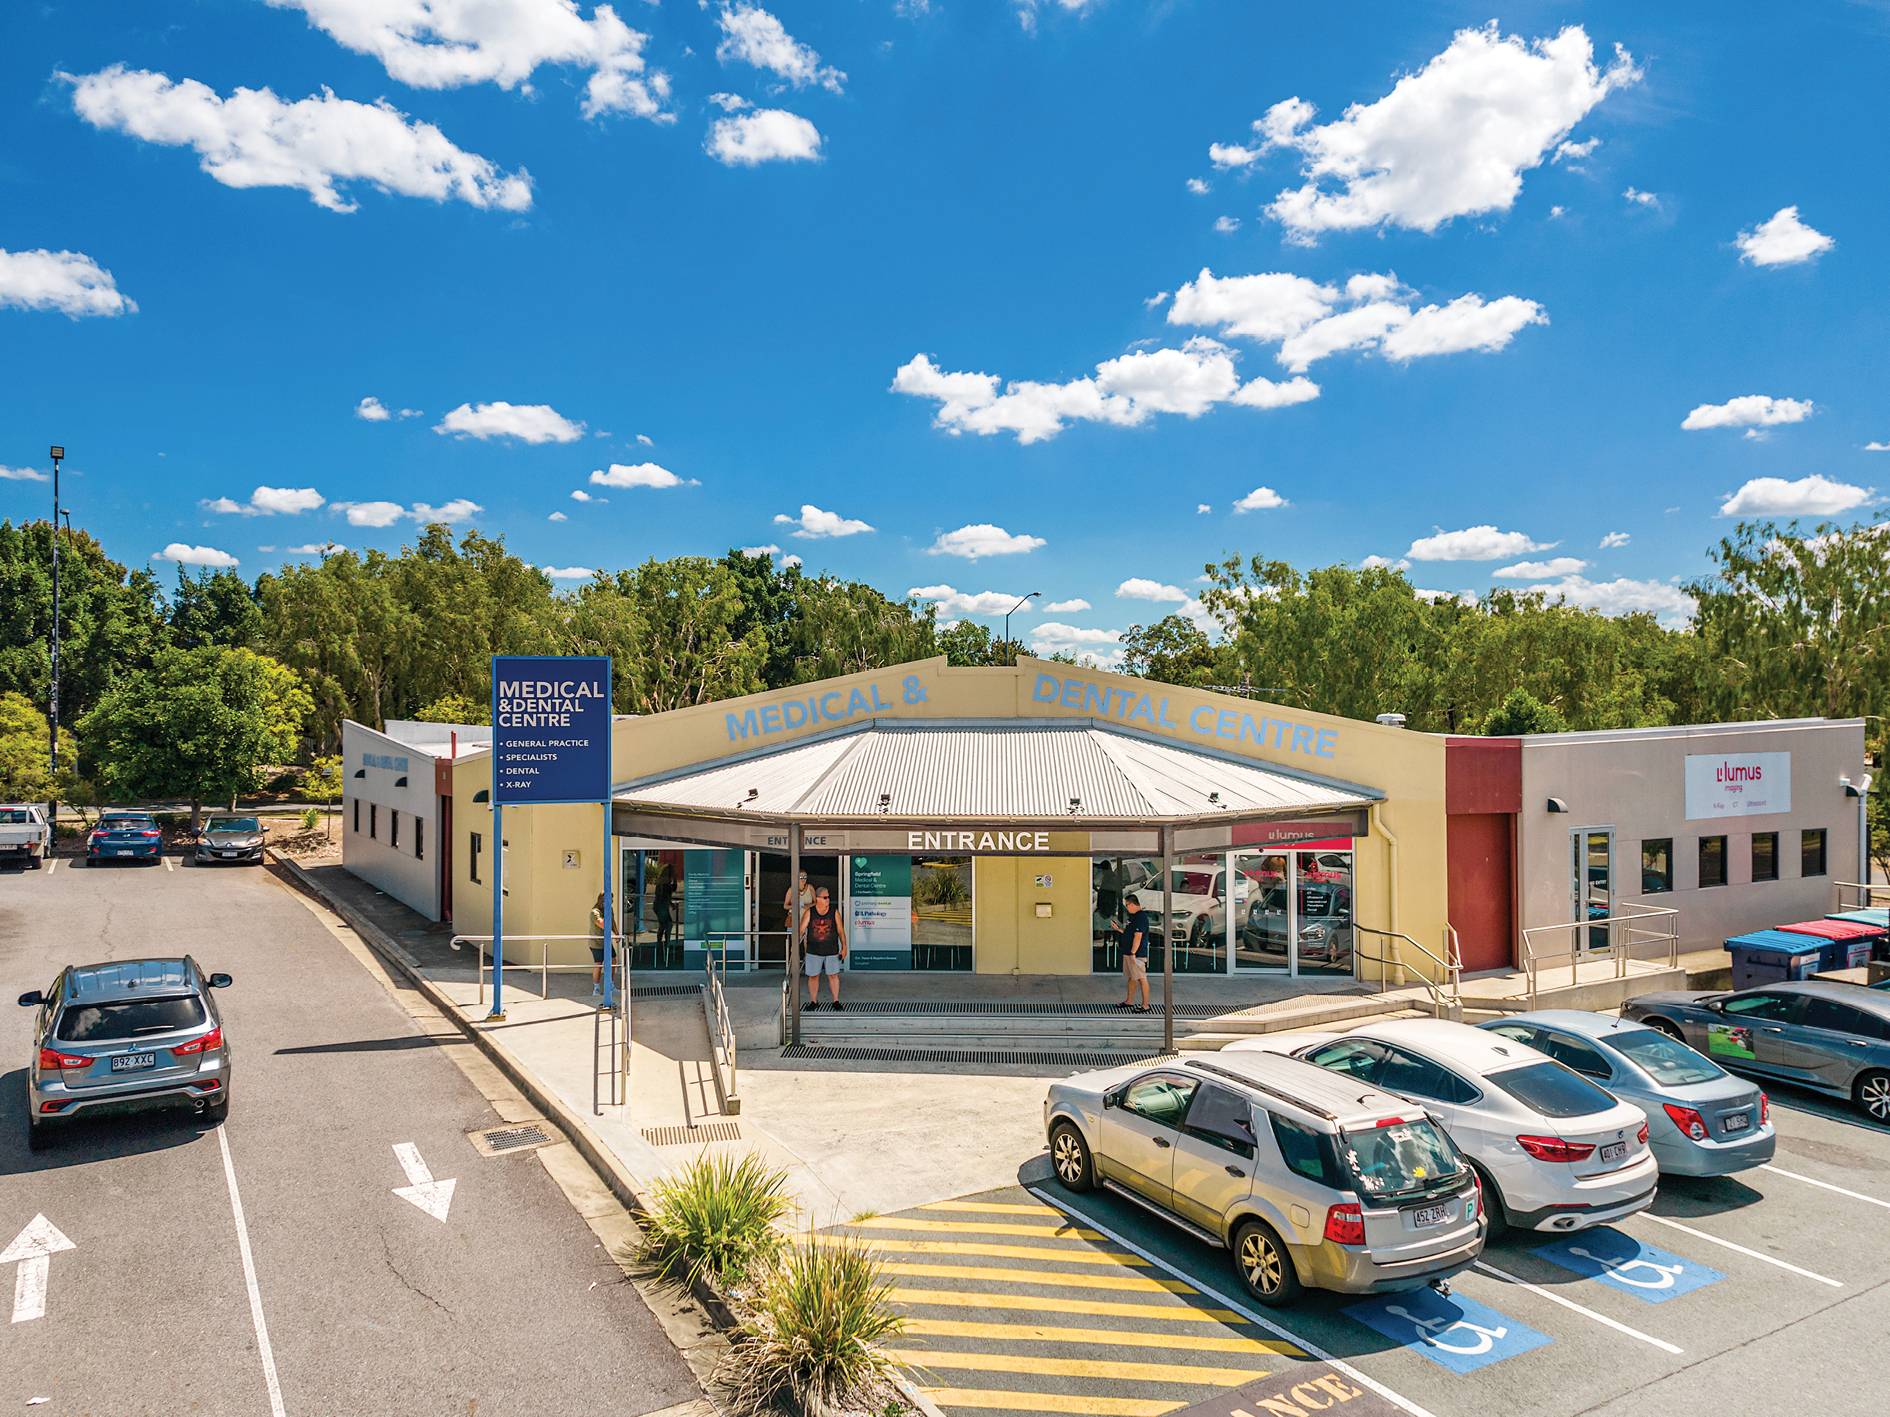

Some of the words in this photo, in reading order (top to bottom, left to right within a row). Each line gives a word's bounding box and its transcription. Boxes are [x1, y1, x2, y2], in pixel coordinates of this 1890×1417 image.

[499, 681, 604, 698] MEDICAL
[498, 699, 584, 713] &DENTAL
[725, 683, 892, 741] MEDICAL
[902, 674, 928, 705] &
[498, 713, 571, 727] CENTRE
[1032, 673, 1177, 729] DENTAL
[1190, 705, 1338, 759] CENTRE
[506, 740, 546, 748] GENERAL
[506, 753, 558, 761] SPECIALISTS
[506, 767, 540, 775] DENTAL
[768, 836, 827, 845] ENTNCE
[907, 831, 1050, 850] ENTRANCE
[113, 1057, 131, 1067] 892
[134, 1054, 153, 1064] XXC
[1416, 1209, 1428, 1223] 452
[1467, 1203, 1473, 1218] P
